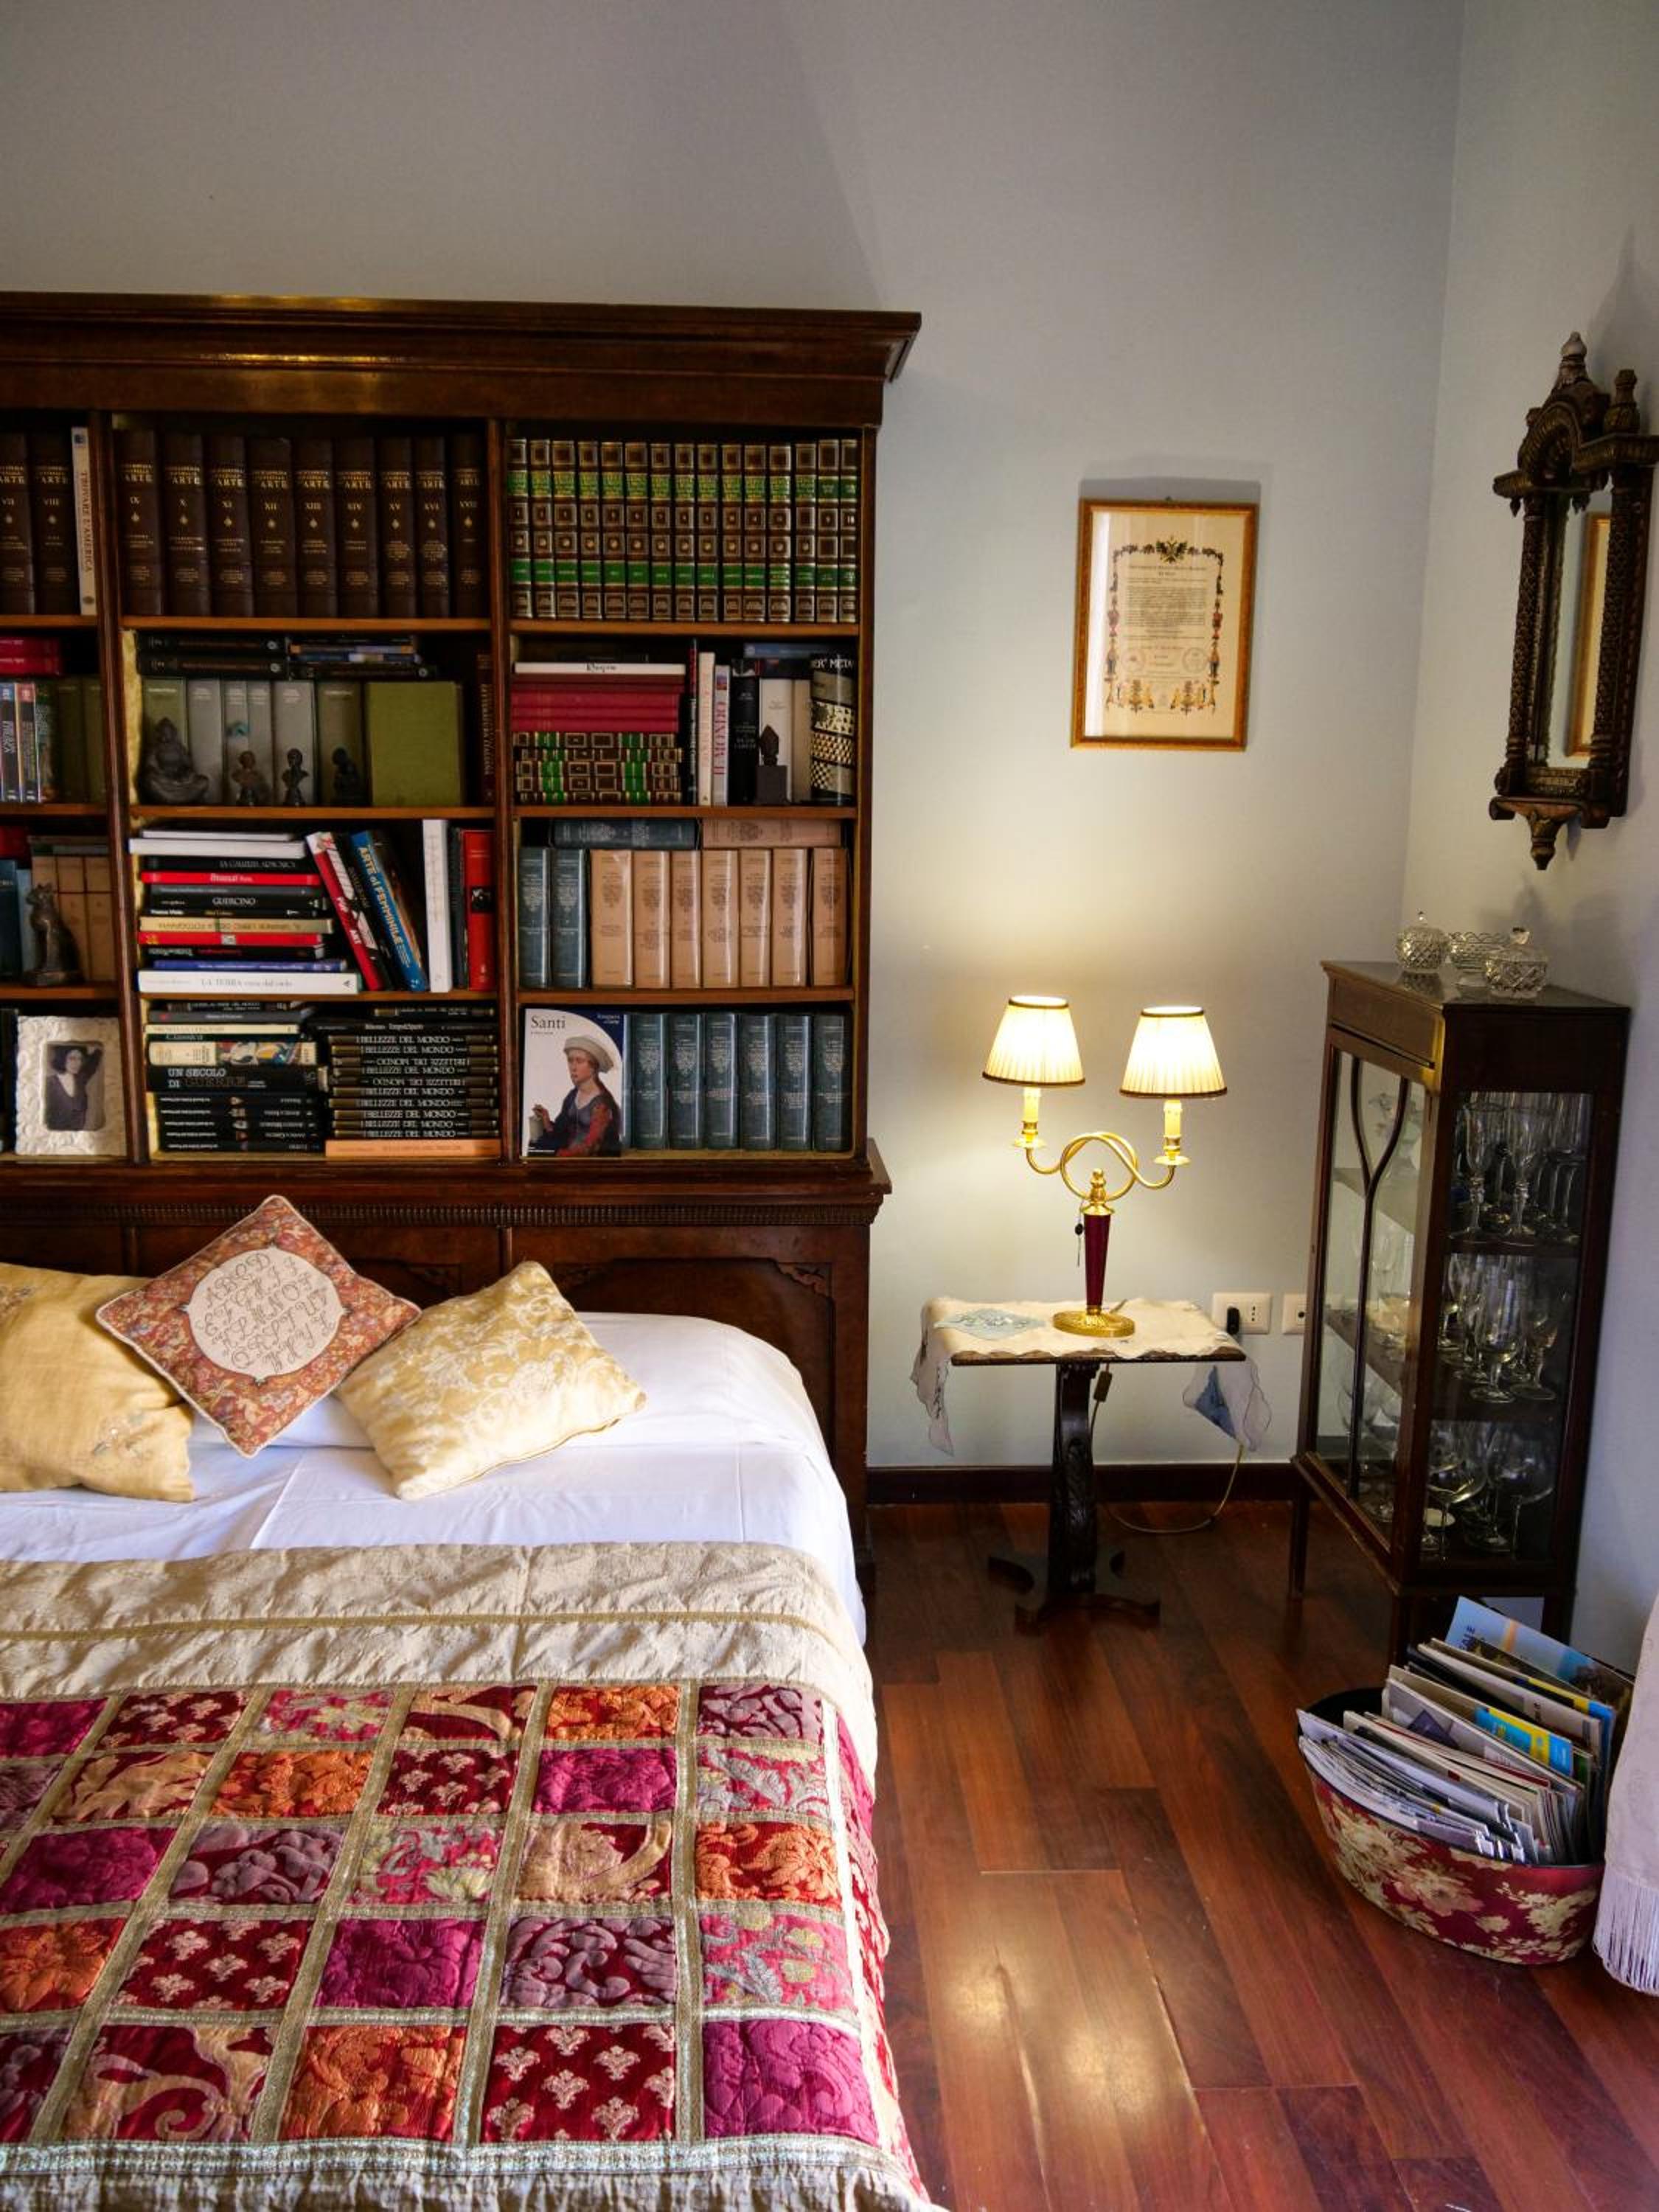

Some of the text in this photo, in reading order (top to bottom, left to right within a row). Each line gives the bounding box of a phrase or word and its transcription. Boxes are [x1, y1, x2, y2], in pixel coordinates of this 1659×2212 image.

[714, 701, 726, 758] MONDO
[358, 846, 378, 874] ARTE
[375, 887, 403, 945] FEMMINILE
[212, 897, 256, 905] GUERCINO
[216, 978, 242, 987] TERRA
[531, 1015, 566, 1029] Santi
[361, 1035, 397, 1043] BELLEZZE
[417, 1036, 451, 1044] MONDO
[421, 1046, 454, 1054] MONDO
[377, 1057, 465, 1066] BELLEZZE DEL MONDO
[167, 1068, 226, 1077] UN SECOLO
[168, 1079, 180, 1088] DI
[365, 1088, 454, 1096] BELLEZZE DEL MONDO
[361, 1099, 396, 1107] BELLEZZE
[399, 1099, 414, 1107] DEL
[366, 1110, 456, 1119] BELLEZZE DEL MONDO
[421, 1120, 453, 1128] MONDO
